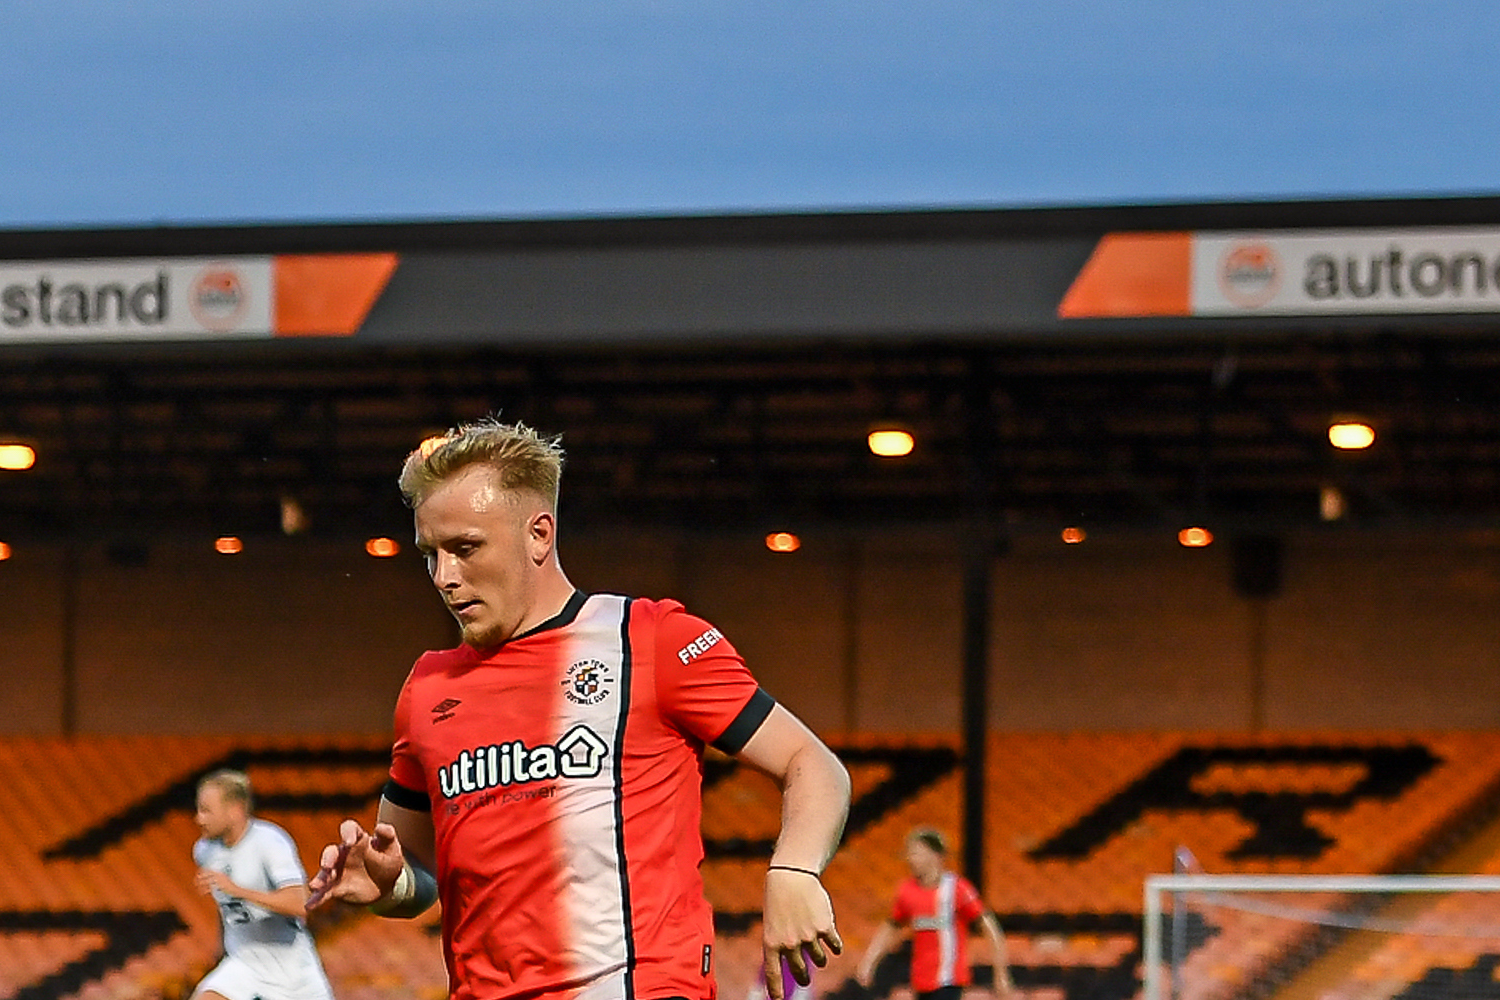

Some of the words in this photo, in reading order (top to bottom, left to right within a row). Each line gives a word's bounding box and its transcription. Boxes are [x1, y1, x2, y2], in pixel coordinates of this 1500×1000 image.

[0, 266, 171, 328] stand
[1303, 242, 1500, 299] auton
[438, 739, 559, 799] utilita
